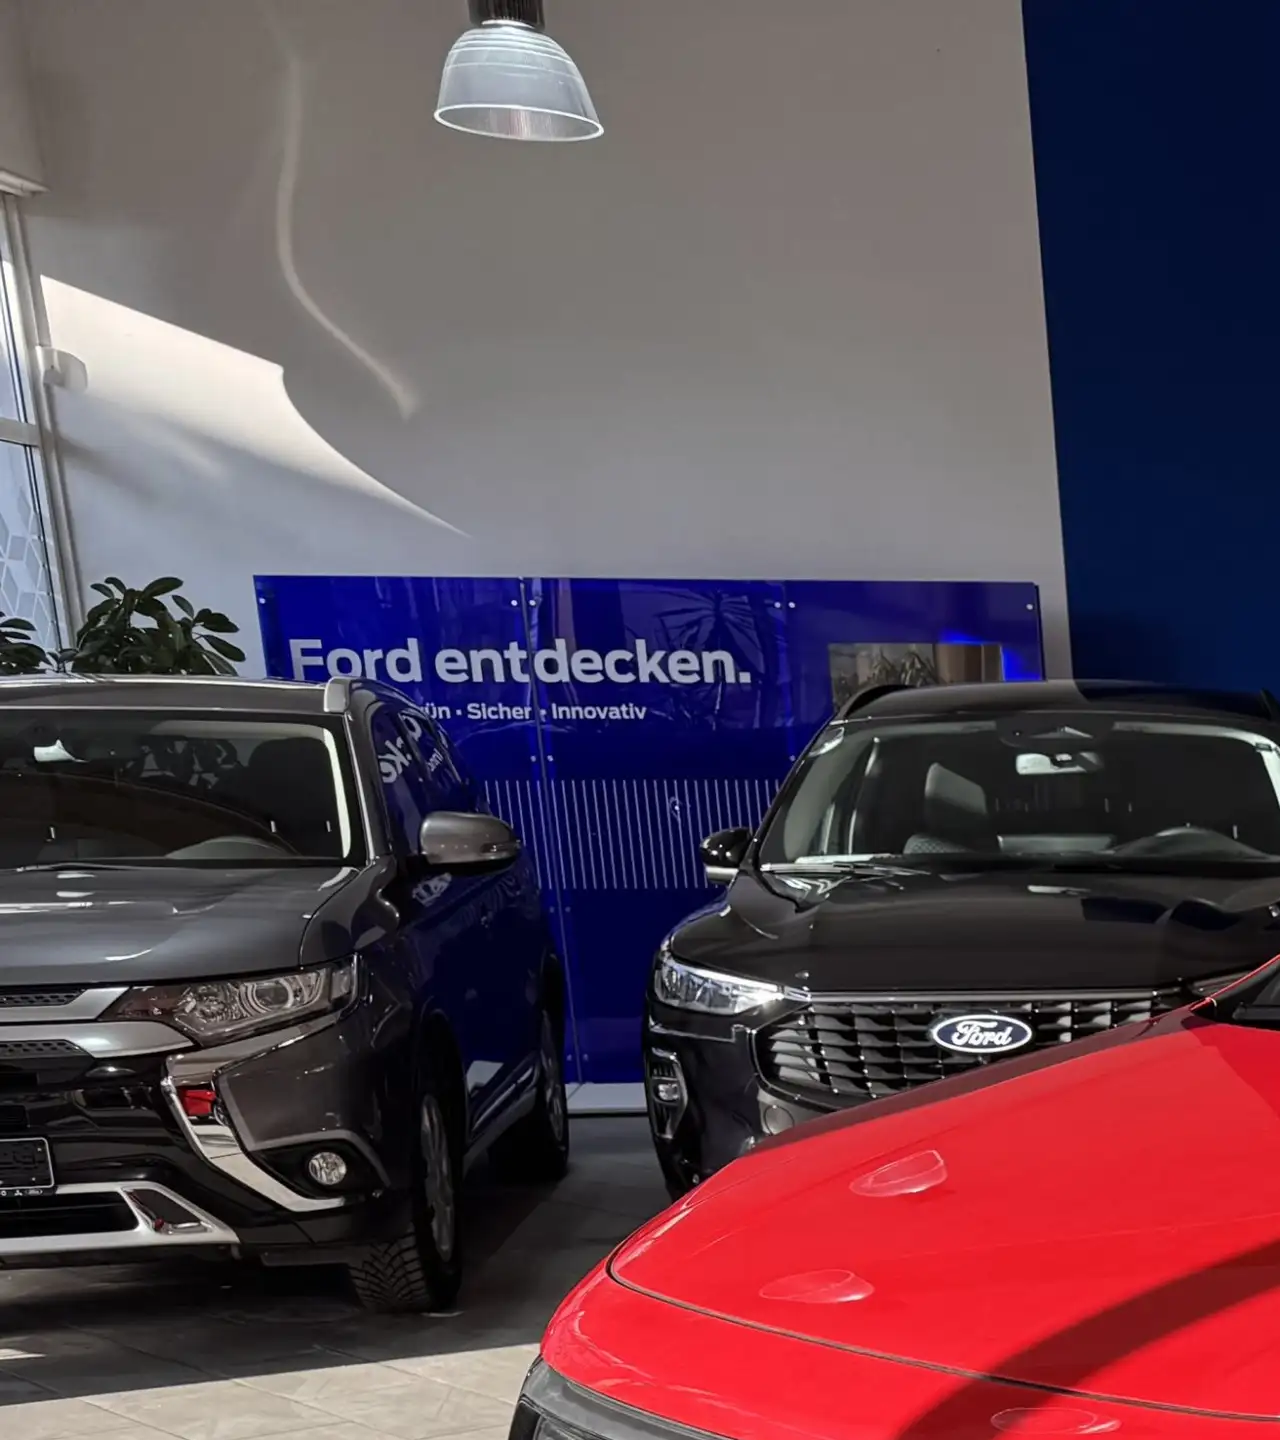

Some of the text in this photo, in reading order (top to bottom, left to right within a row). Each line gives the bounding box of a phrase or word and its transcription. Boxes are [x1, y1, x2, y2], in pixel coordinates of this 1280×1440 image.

[289, 637, 752, 684] Ford entdecken.
[467, 703, 532, 720] Sicher
[551, 703, 647, 720] Innovativ
[952, 1020, 1013, 1046] Ford
